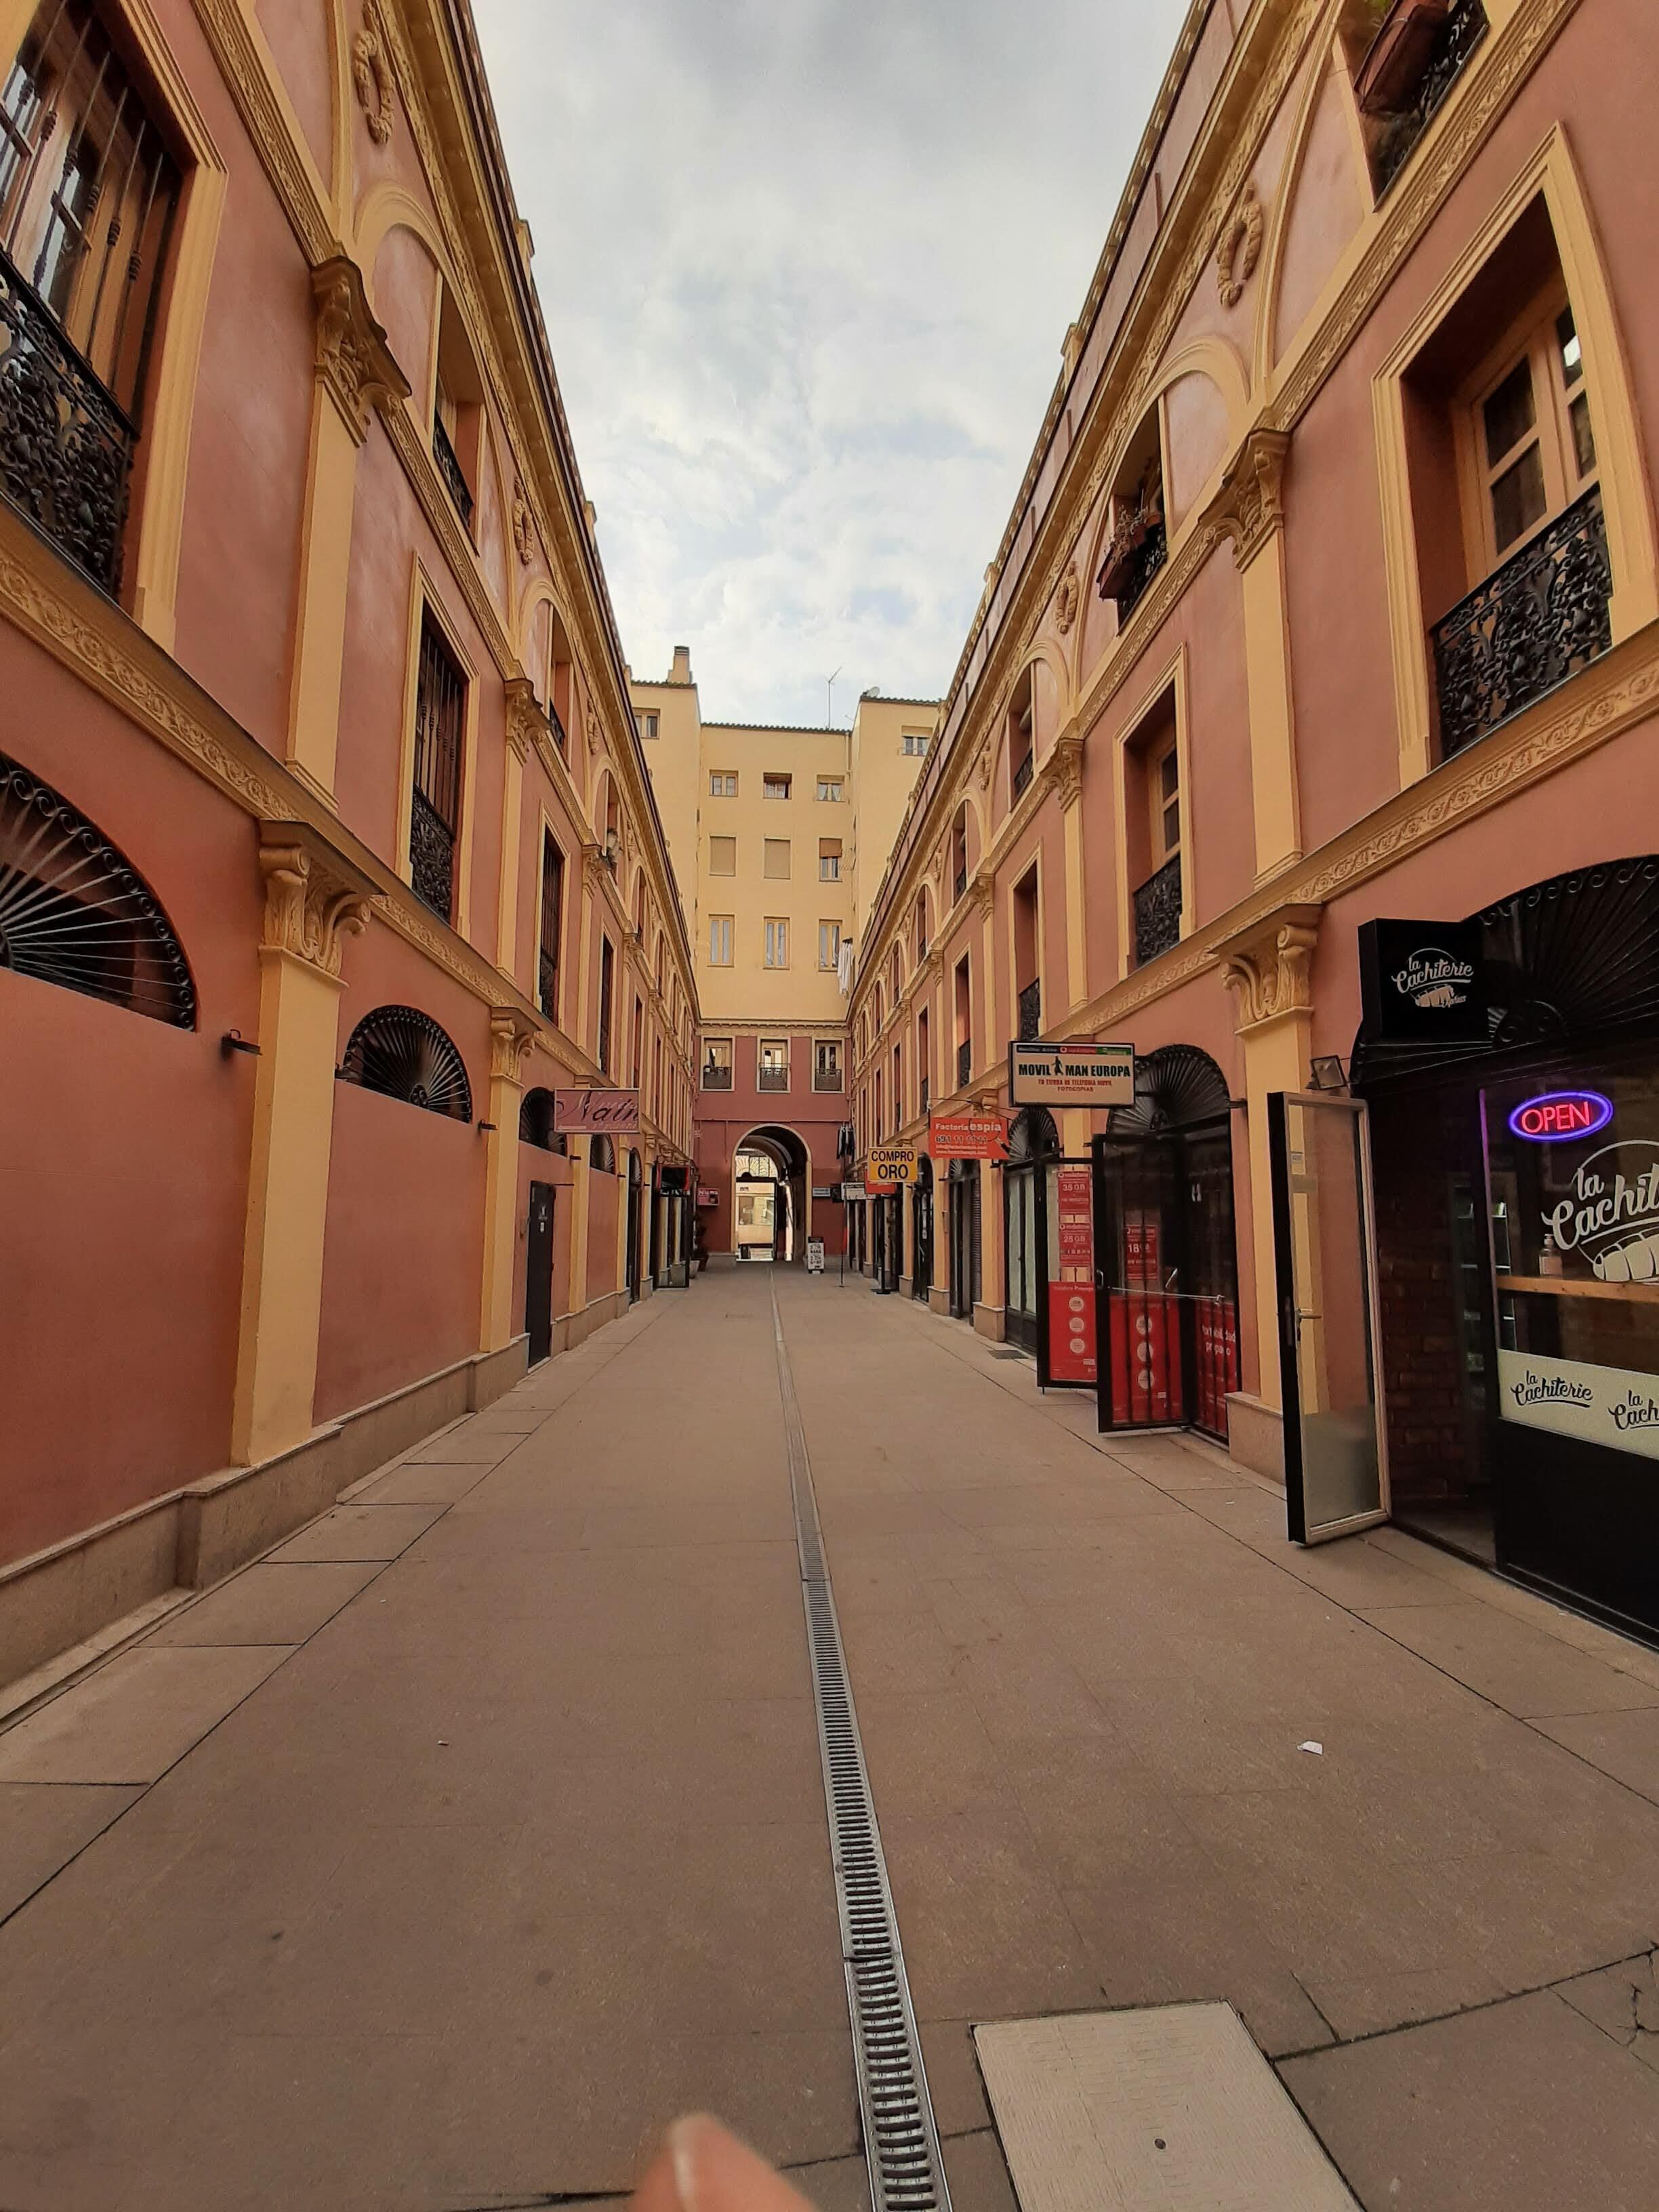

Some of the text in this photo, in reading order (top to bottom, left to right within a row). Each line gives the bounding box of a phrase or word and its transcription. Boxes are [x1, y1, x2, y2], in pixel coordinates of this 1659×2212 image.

[1408, 956, 1421, 972] la
[1391, 958, 1474, 994] Cachiterie
[1019, 1064, 1131, 1077] MOVIL MAN EUROPA
[1521, 1101, 1591, 1134] OPEN
[872, 1151, 914, 1162] COMPRO
[878, 1164, 908, 1179] ORO
[1577, 1167, 1605, 1201] la
[1526, 1370, 1538, 1385] la
[1511, 1377, 1593, 1406] Cachiterie
[1628, 1389, 1643, 1406] la
